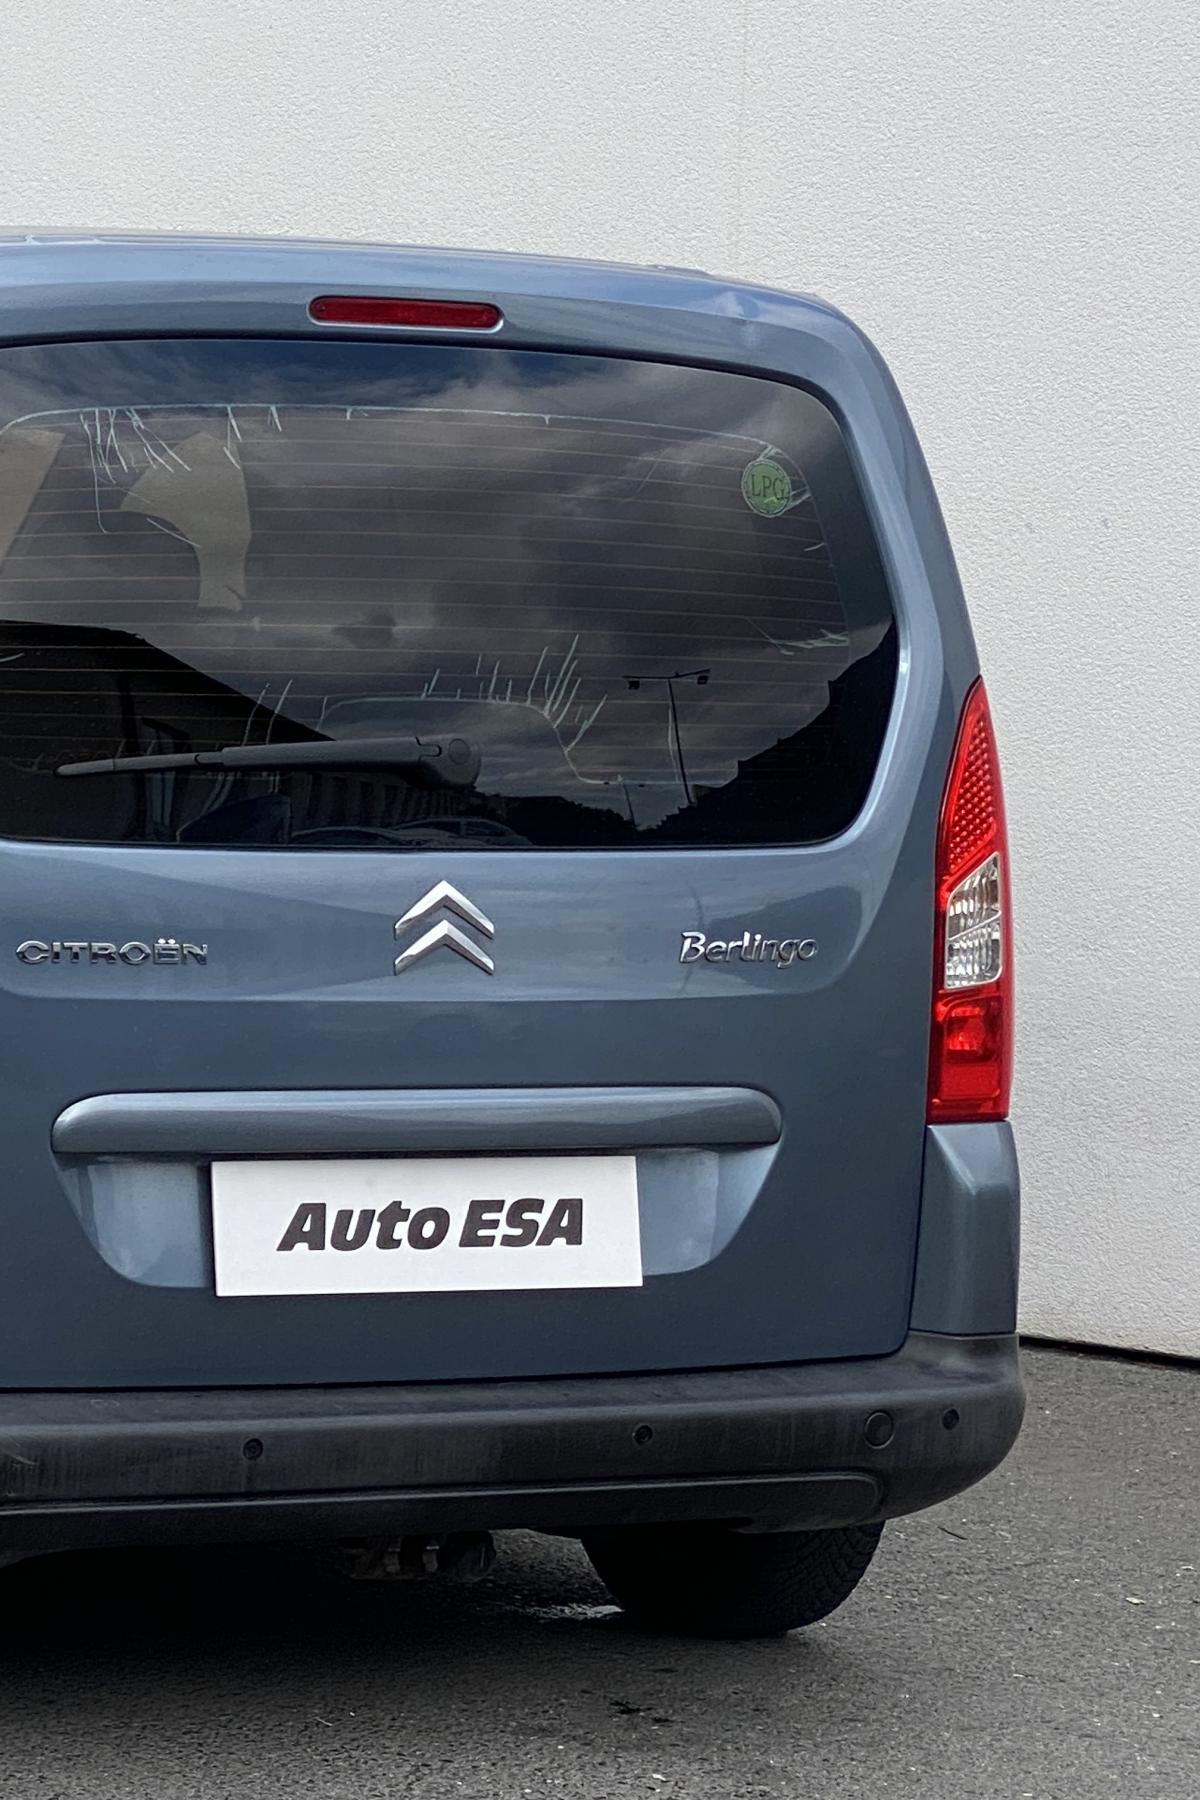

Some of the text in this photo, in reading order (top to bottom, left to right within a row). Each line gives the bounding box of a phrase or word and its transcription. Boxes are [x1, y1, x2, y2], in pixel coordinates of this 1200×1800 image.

[751, 473, 785, 501] LPG
[16, 938, 208, 964] CITROËN
[680, 931, 818, 969] Berlingo
[276, 1198, 583, 1251] Auto ESA
